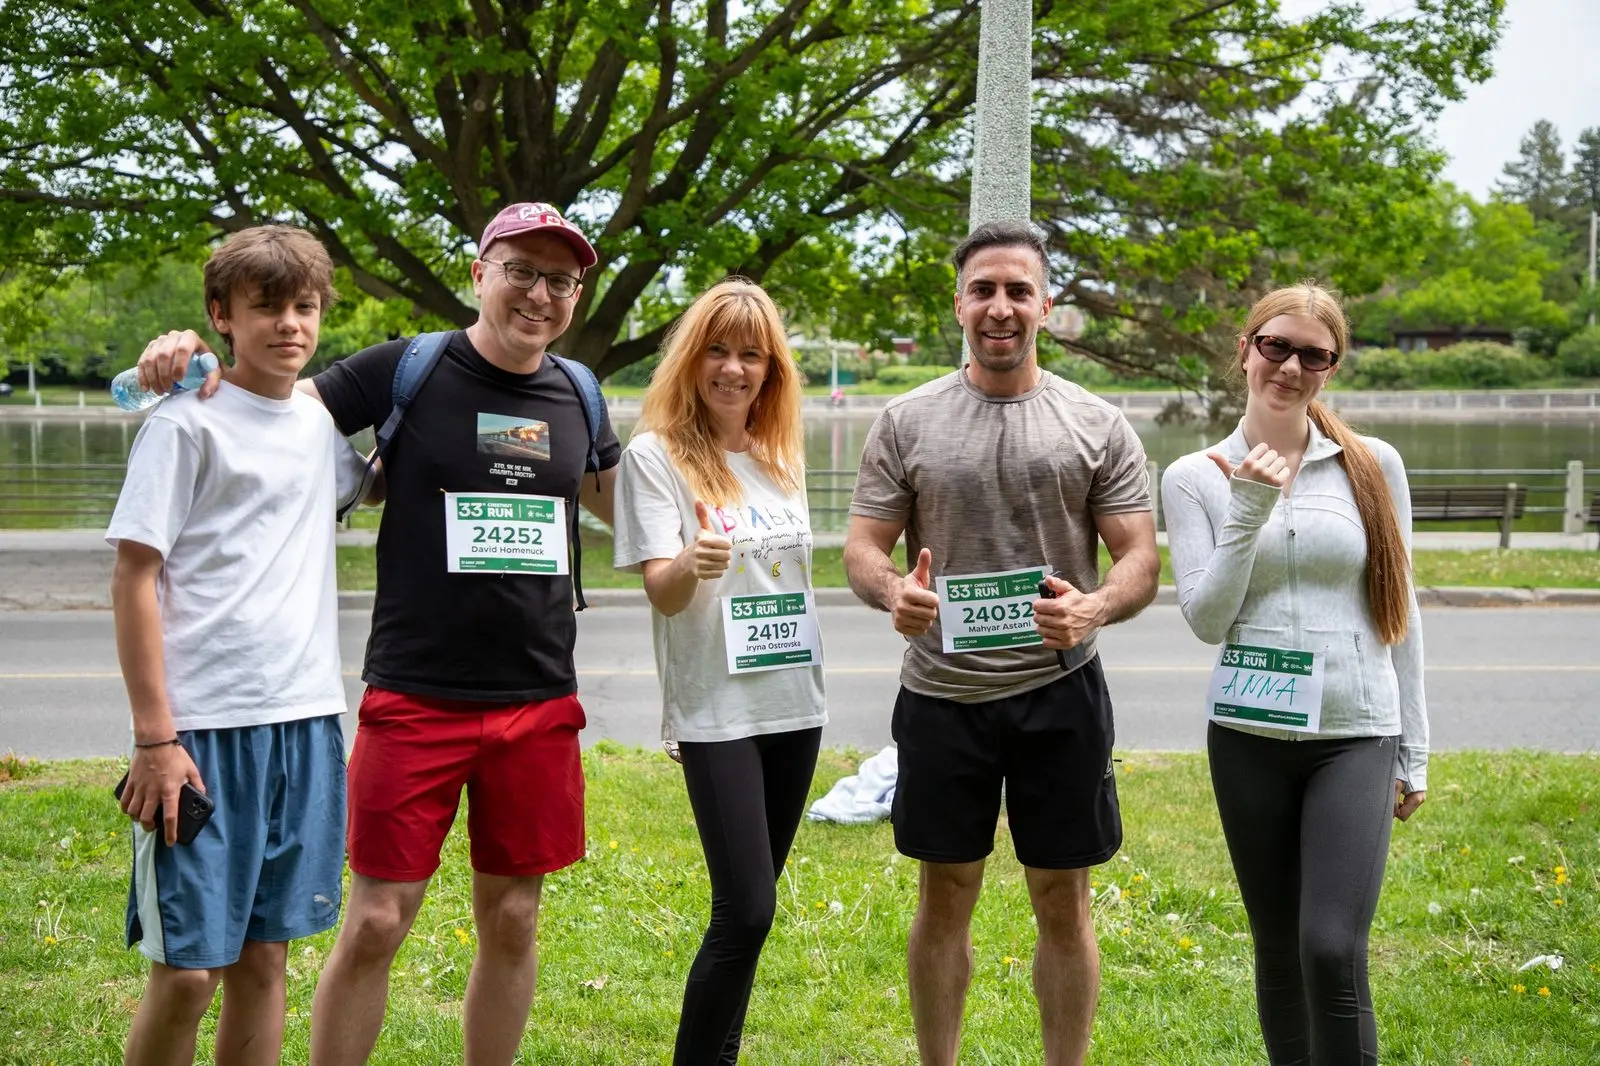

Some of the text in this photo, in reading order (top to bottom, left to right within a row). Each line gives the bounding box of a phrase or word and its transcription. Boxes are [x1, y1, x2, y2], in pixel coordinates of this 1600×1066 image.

[487, 507, 513, 518] RUN
[472, 526, 543, 545] 24252
[471, 545, 544, 555] David Homenuck
[974, 586, 1000, 598] RUN
[756, 604, 778, 616] RUN
[962, 601, 1034, 624] 24032
[747, 621, 798, 642] 24197
[969, 620, 1031, 633] Mahyar Astani
[746, 640, 801, 653] Iryna Ostrovska
[1242, 656, 1267, 667] RUN
[1222, 669, 1298, 706] ANNA
